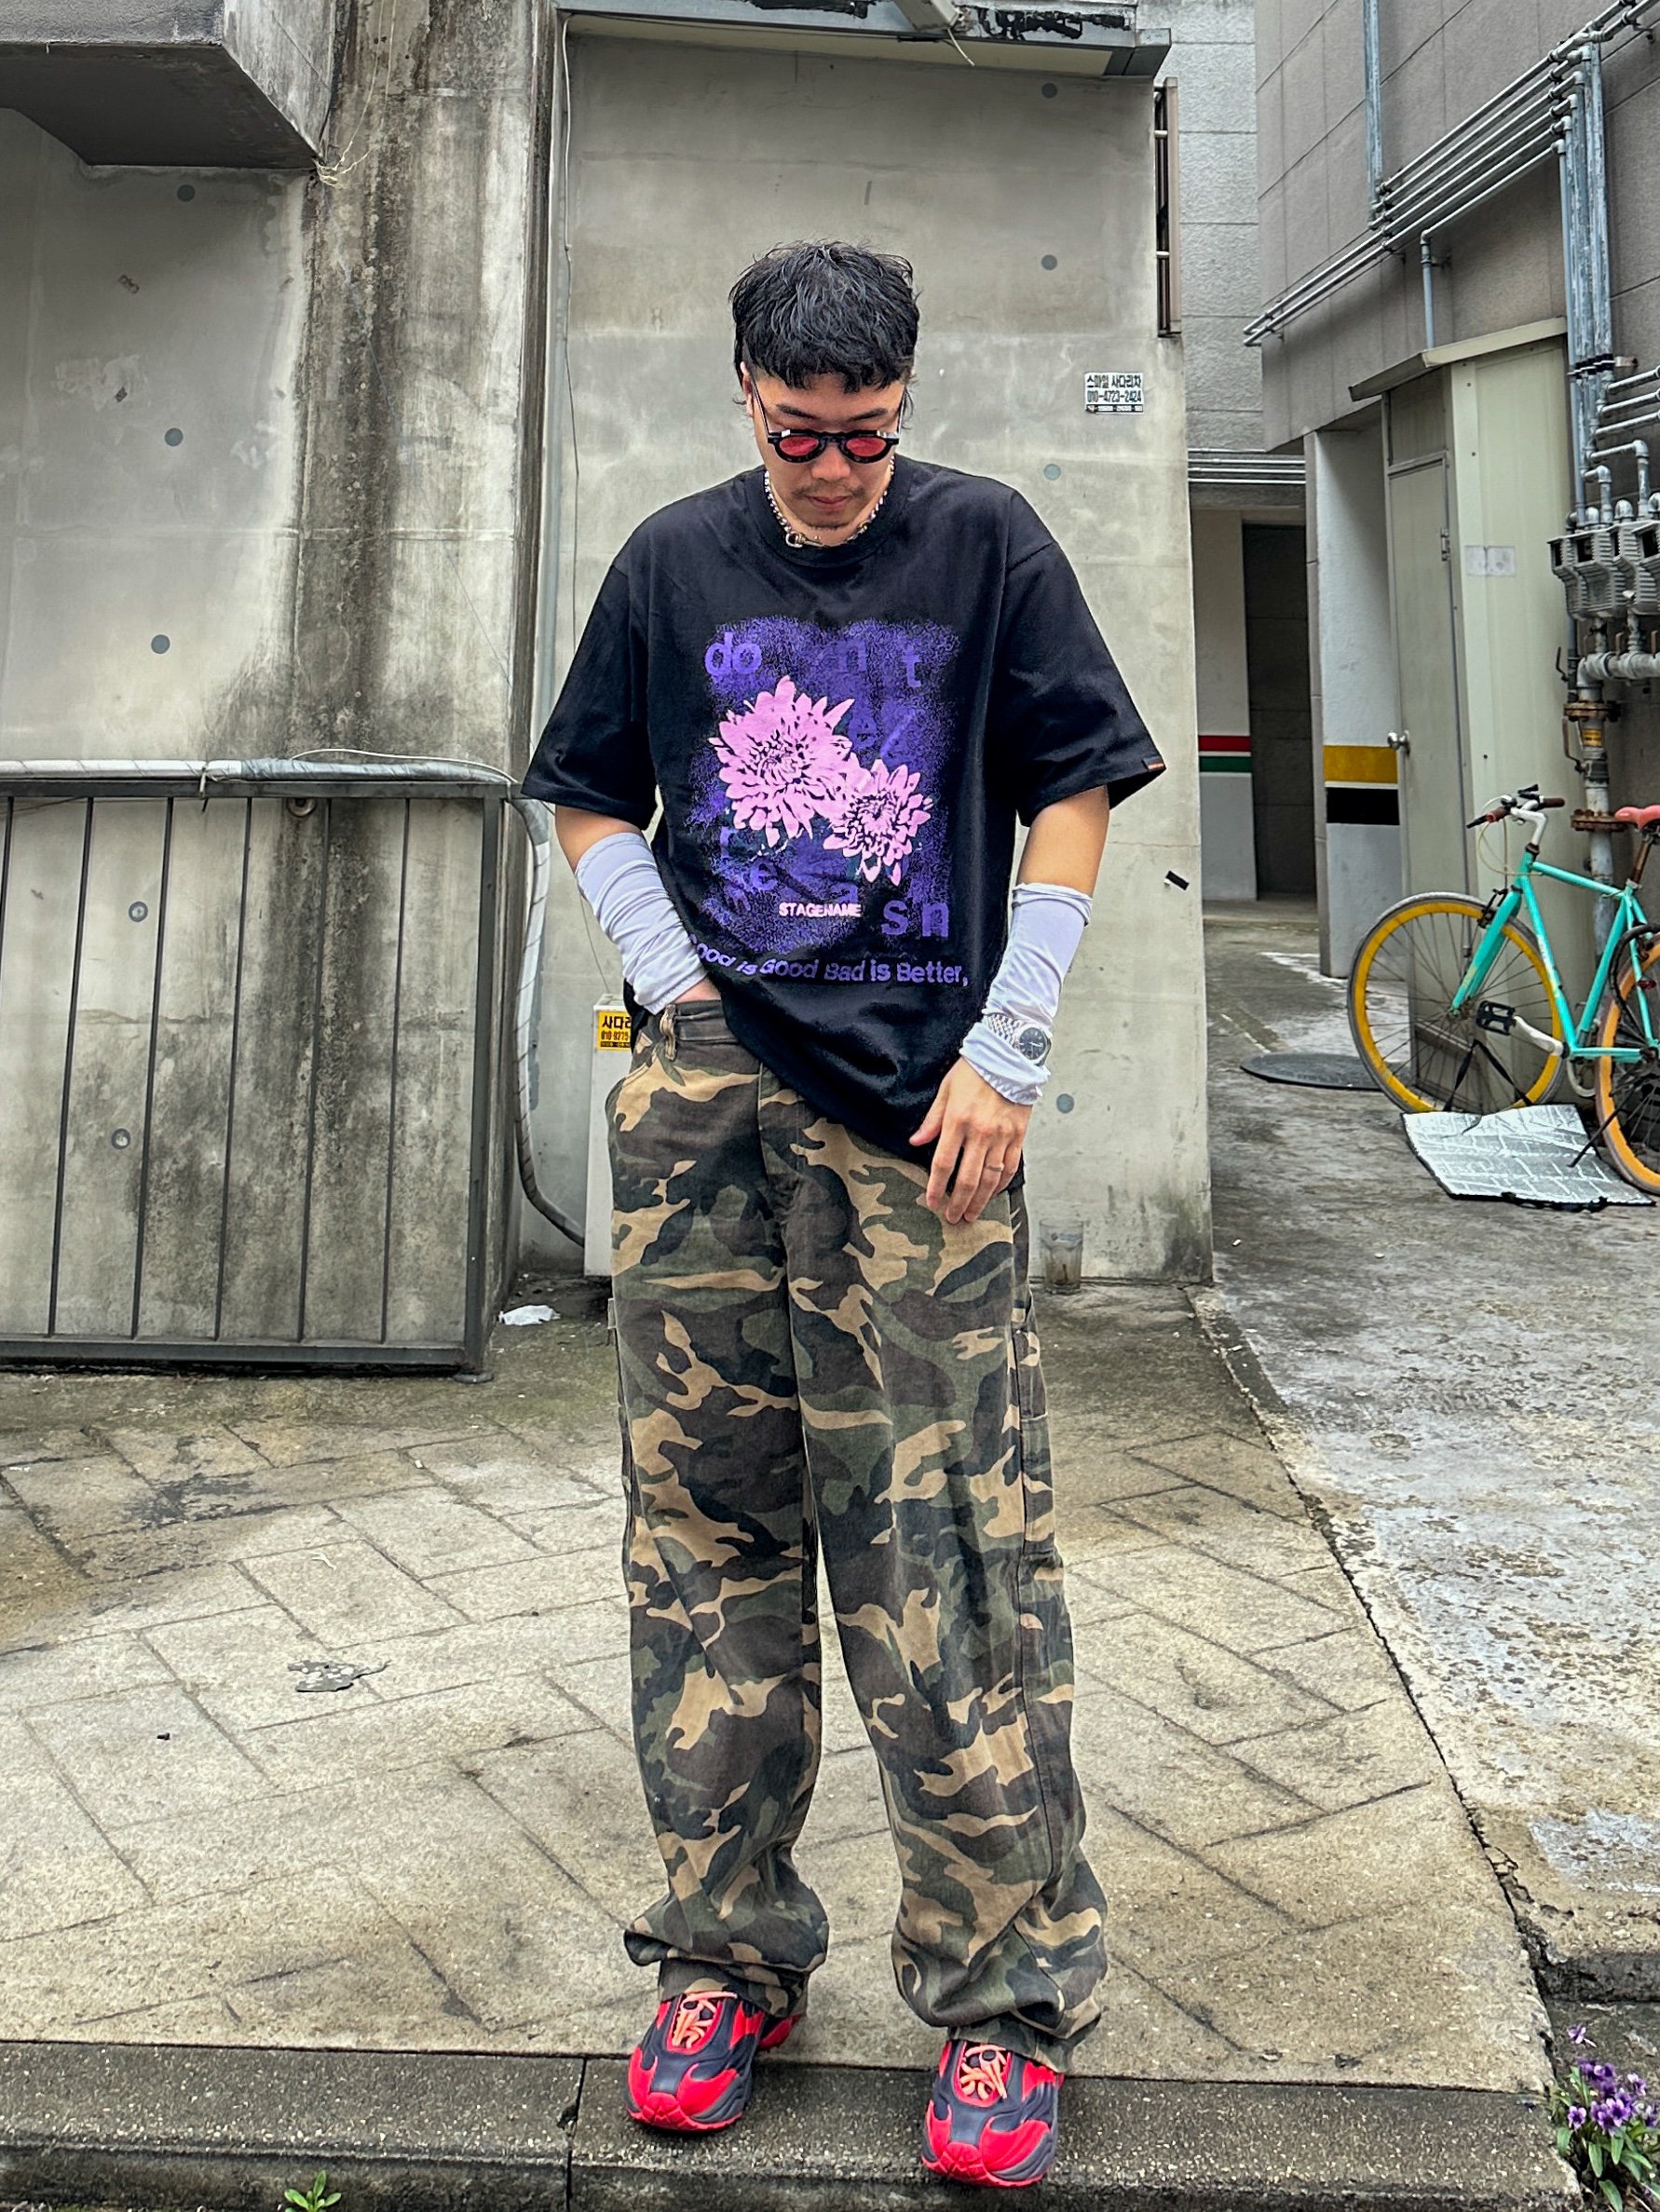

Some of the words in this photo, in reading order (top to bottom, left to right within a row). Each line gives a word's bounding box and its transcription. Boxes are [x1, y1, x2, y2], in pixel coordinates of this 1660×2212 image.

[1087, 375, 1109, 388] 스마일
[1111, 375, 1141, 388] 사다리차
[779, 902, 861, 917] STAGENAME
[759, 958, 819, 978] Good
[823, 959, 866, 982] Bad
[869, 958, 891, 982] is
